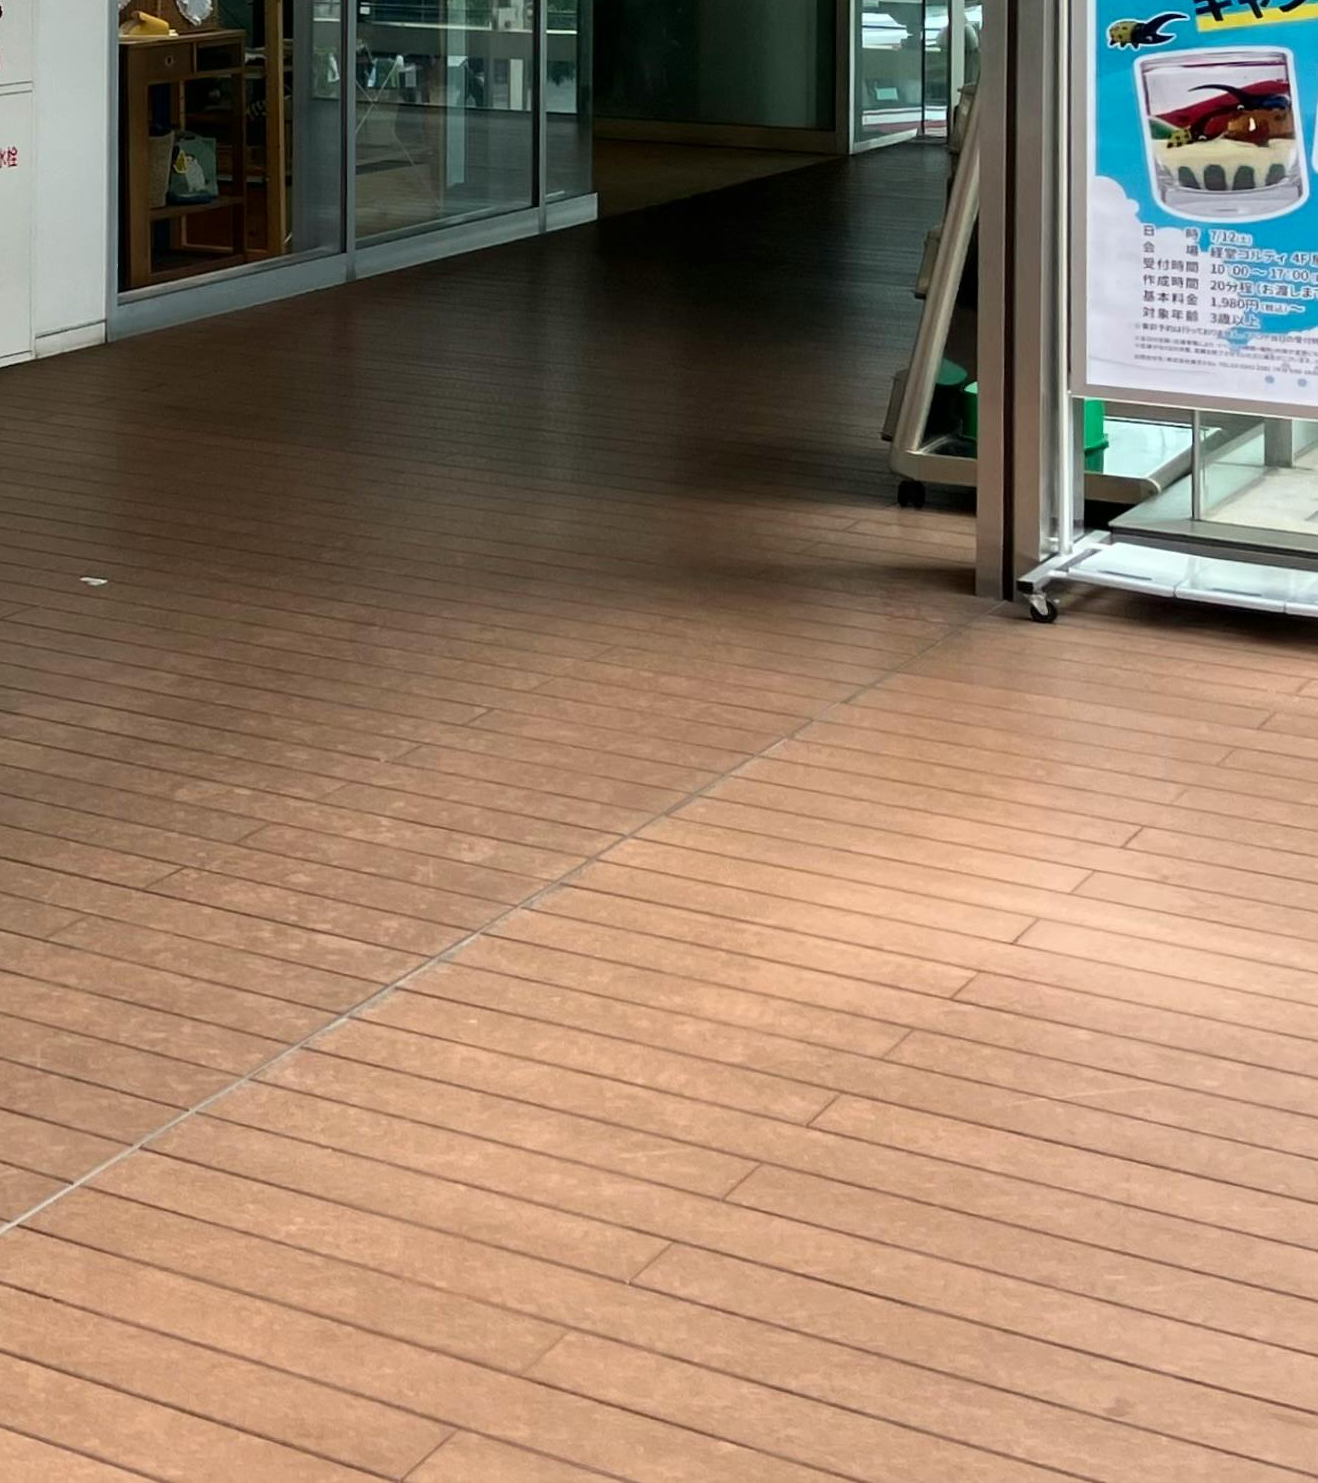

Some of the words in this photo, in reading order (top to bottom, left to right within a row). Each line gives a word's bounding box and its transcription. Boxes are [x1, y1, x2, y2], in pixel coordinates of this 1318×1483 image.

[1210, 247, 1285, 264] 経堂コルティ
[1142, 258, 1199, 274] 受付時間
[1142, 274, 1199, 290] 作成時間
[1142, 290, 1199, 306] 基本料金
[1142, 306, 1199, 322] 対象年齢
